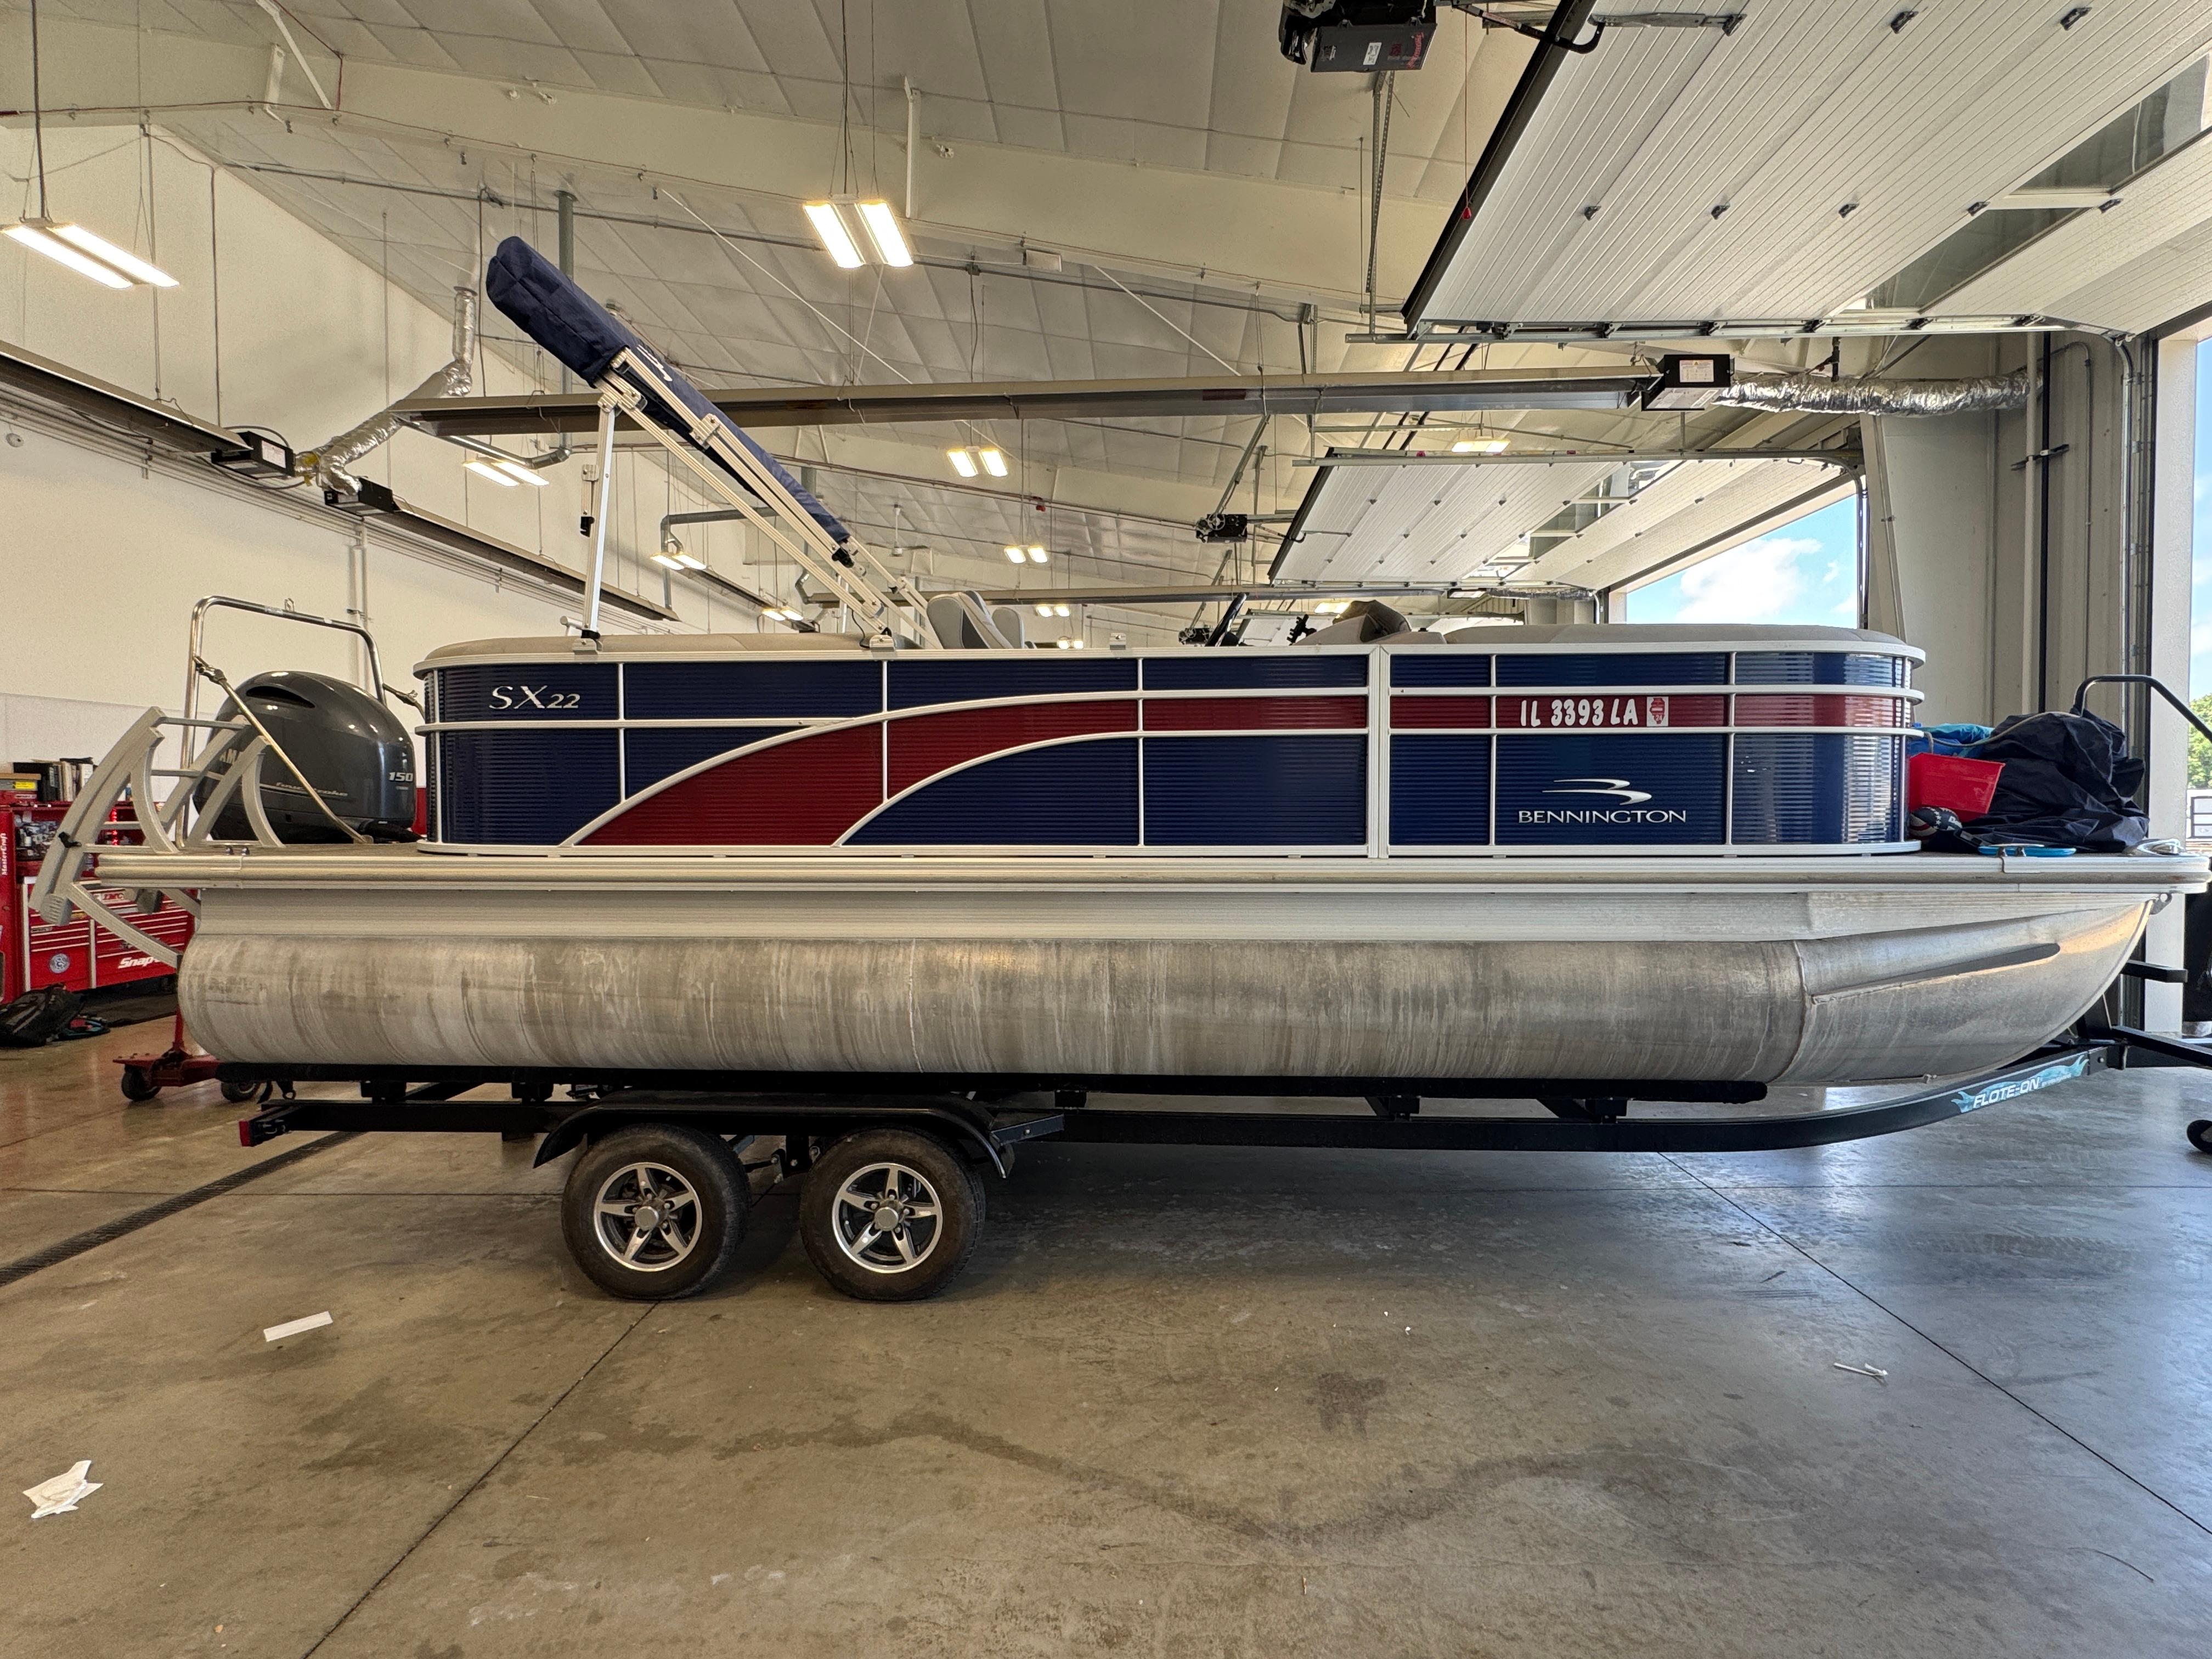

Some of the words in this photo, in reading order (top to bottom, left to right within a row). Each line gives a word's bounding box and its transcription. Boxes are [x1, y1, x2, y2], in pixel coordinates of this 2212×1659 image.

[489, 685, 580, 709] SX22
[1520, 699, 1541, 727] IL
[1551, 698, 1604, 726] 3393
[1610, 698, 1638, 725] LA
[389, 771, 413, 782] 150
[1518, 810, 1686, 823] BENNINGTON
[1973, 1076, 2041, 1109] FLOTE-ON
